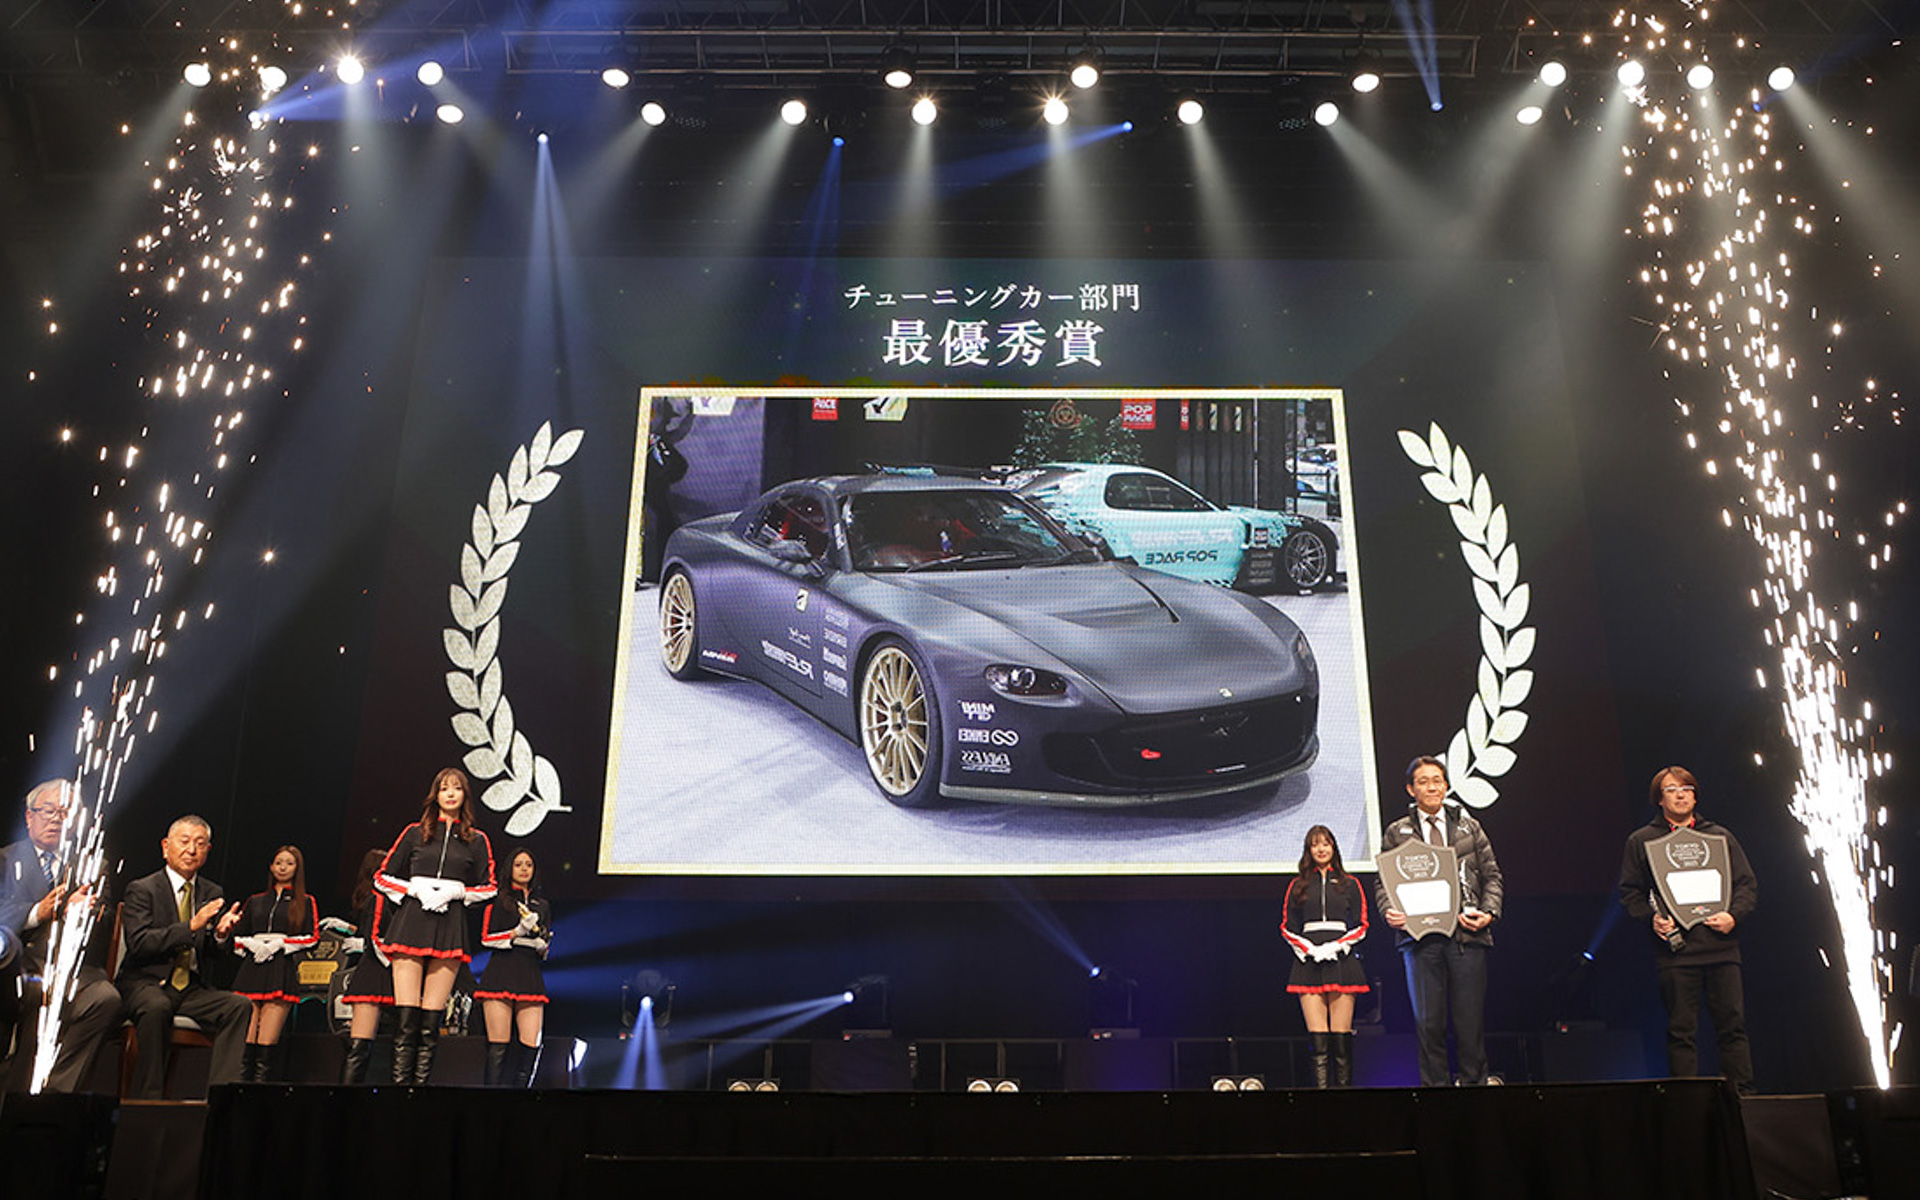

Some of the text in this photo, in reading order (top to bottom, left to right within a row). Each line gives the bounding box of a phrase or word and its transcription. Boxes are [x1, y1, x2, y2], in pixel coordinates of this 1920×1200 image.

[843, 283, 1141, 312] チューニングカー部門
[882, 318, 1104, 368] 最優秀賞
[1123, 404, 1153, 414] POP
